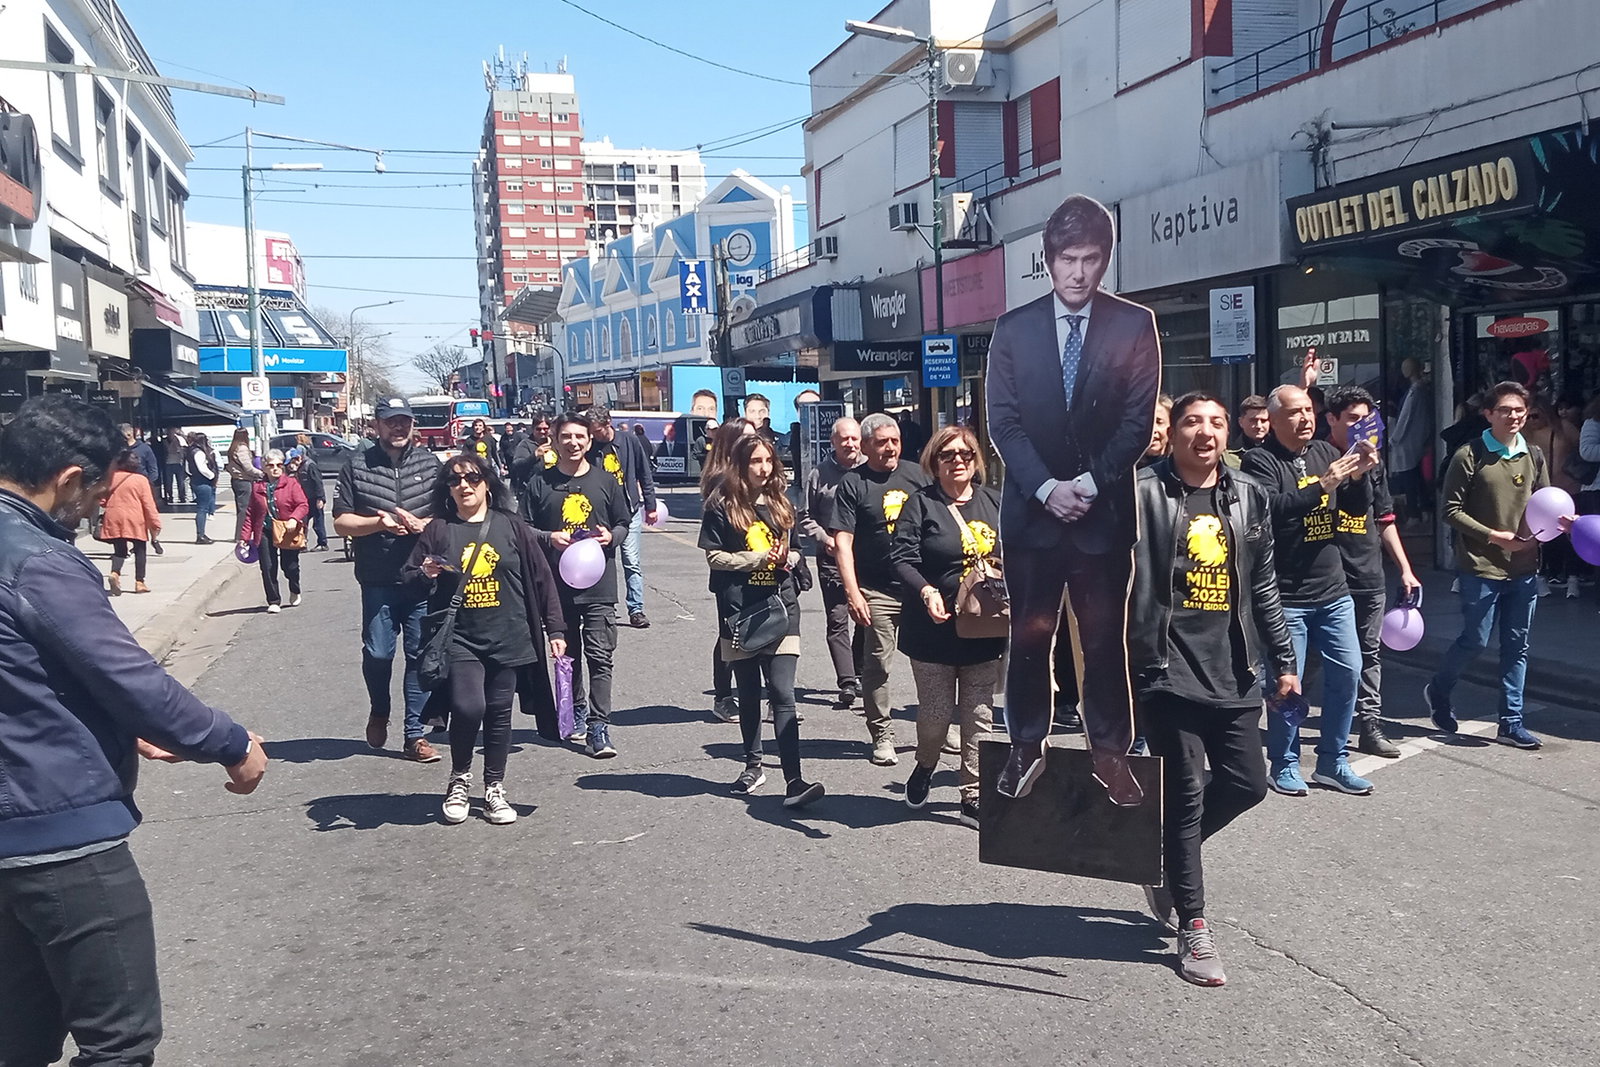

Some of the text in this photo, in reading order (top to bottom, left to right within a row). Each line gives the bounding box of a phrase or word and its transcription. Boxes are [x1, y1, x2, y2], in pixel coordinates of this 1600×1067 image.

[1295, 156, 1519, 244] OUTLET DEL CALZADO
[1150, 195, 1239, 246] Kaptiva
[684, 261, 702, 308] TAXI
[736, 274, 753, 287] iag
[871, 289, 906, 329] Wrangler
[967, 336, 988, 349] UFO
[857, 349, 915, 367] Wrangler
[924, 357, 957, 365] RESERVADO
[1303, 513, 1333, 527] MILEI
[1340, 519, 1365, 529] 2023
[1307, 525, 1332, 536] 2023
[1303, 535, 1317, 543] SAN
[463, 581, 500, 594] MILEI
[1186, 572, 1231, 590] MILEI
[466, 592, 496, 603] 2023
[1190, 588, 1227, 603] 2023
[478, 600, 501, 608] ISIDRO
[1182, 600, 1231, 611] SAN ISIDRO
